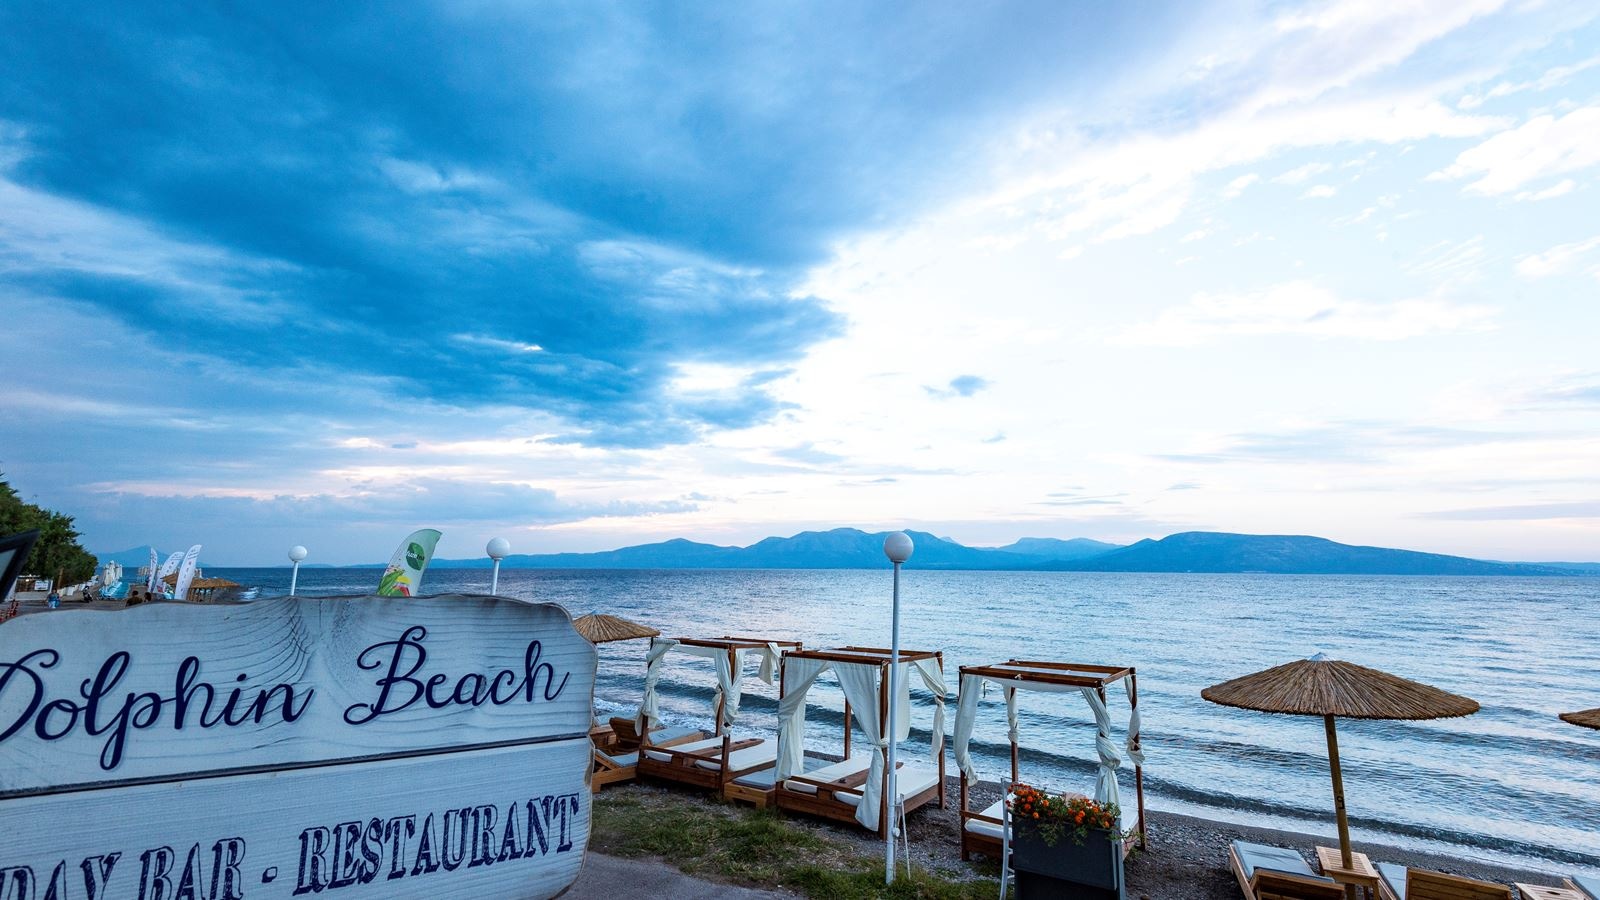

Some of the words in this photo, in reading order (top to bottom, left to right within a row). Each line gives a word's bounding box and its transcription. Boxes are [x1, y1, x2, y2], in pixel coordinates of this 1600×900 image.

[343, 625, 570, 725] Beach
[138, 837, 246, 900] BAR
[292, 792, 580, 896] RESTAURANT
